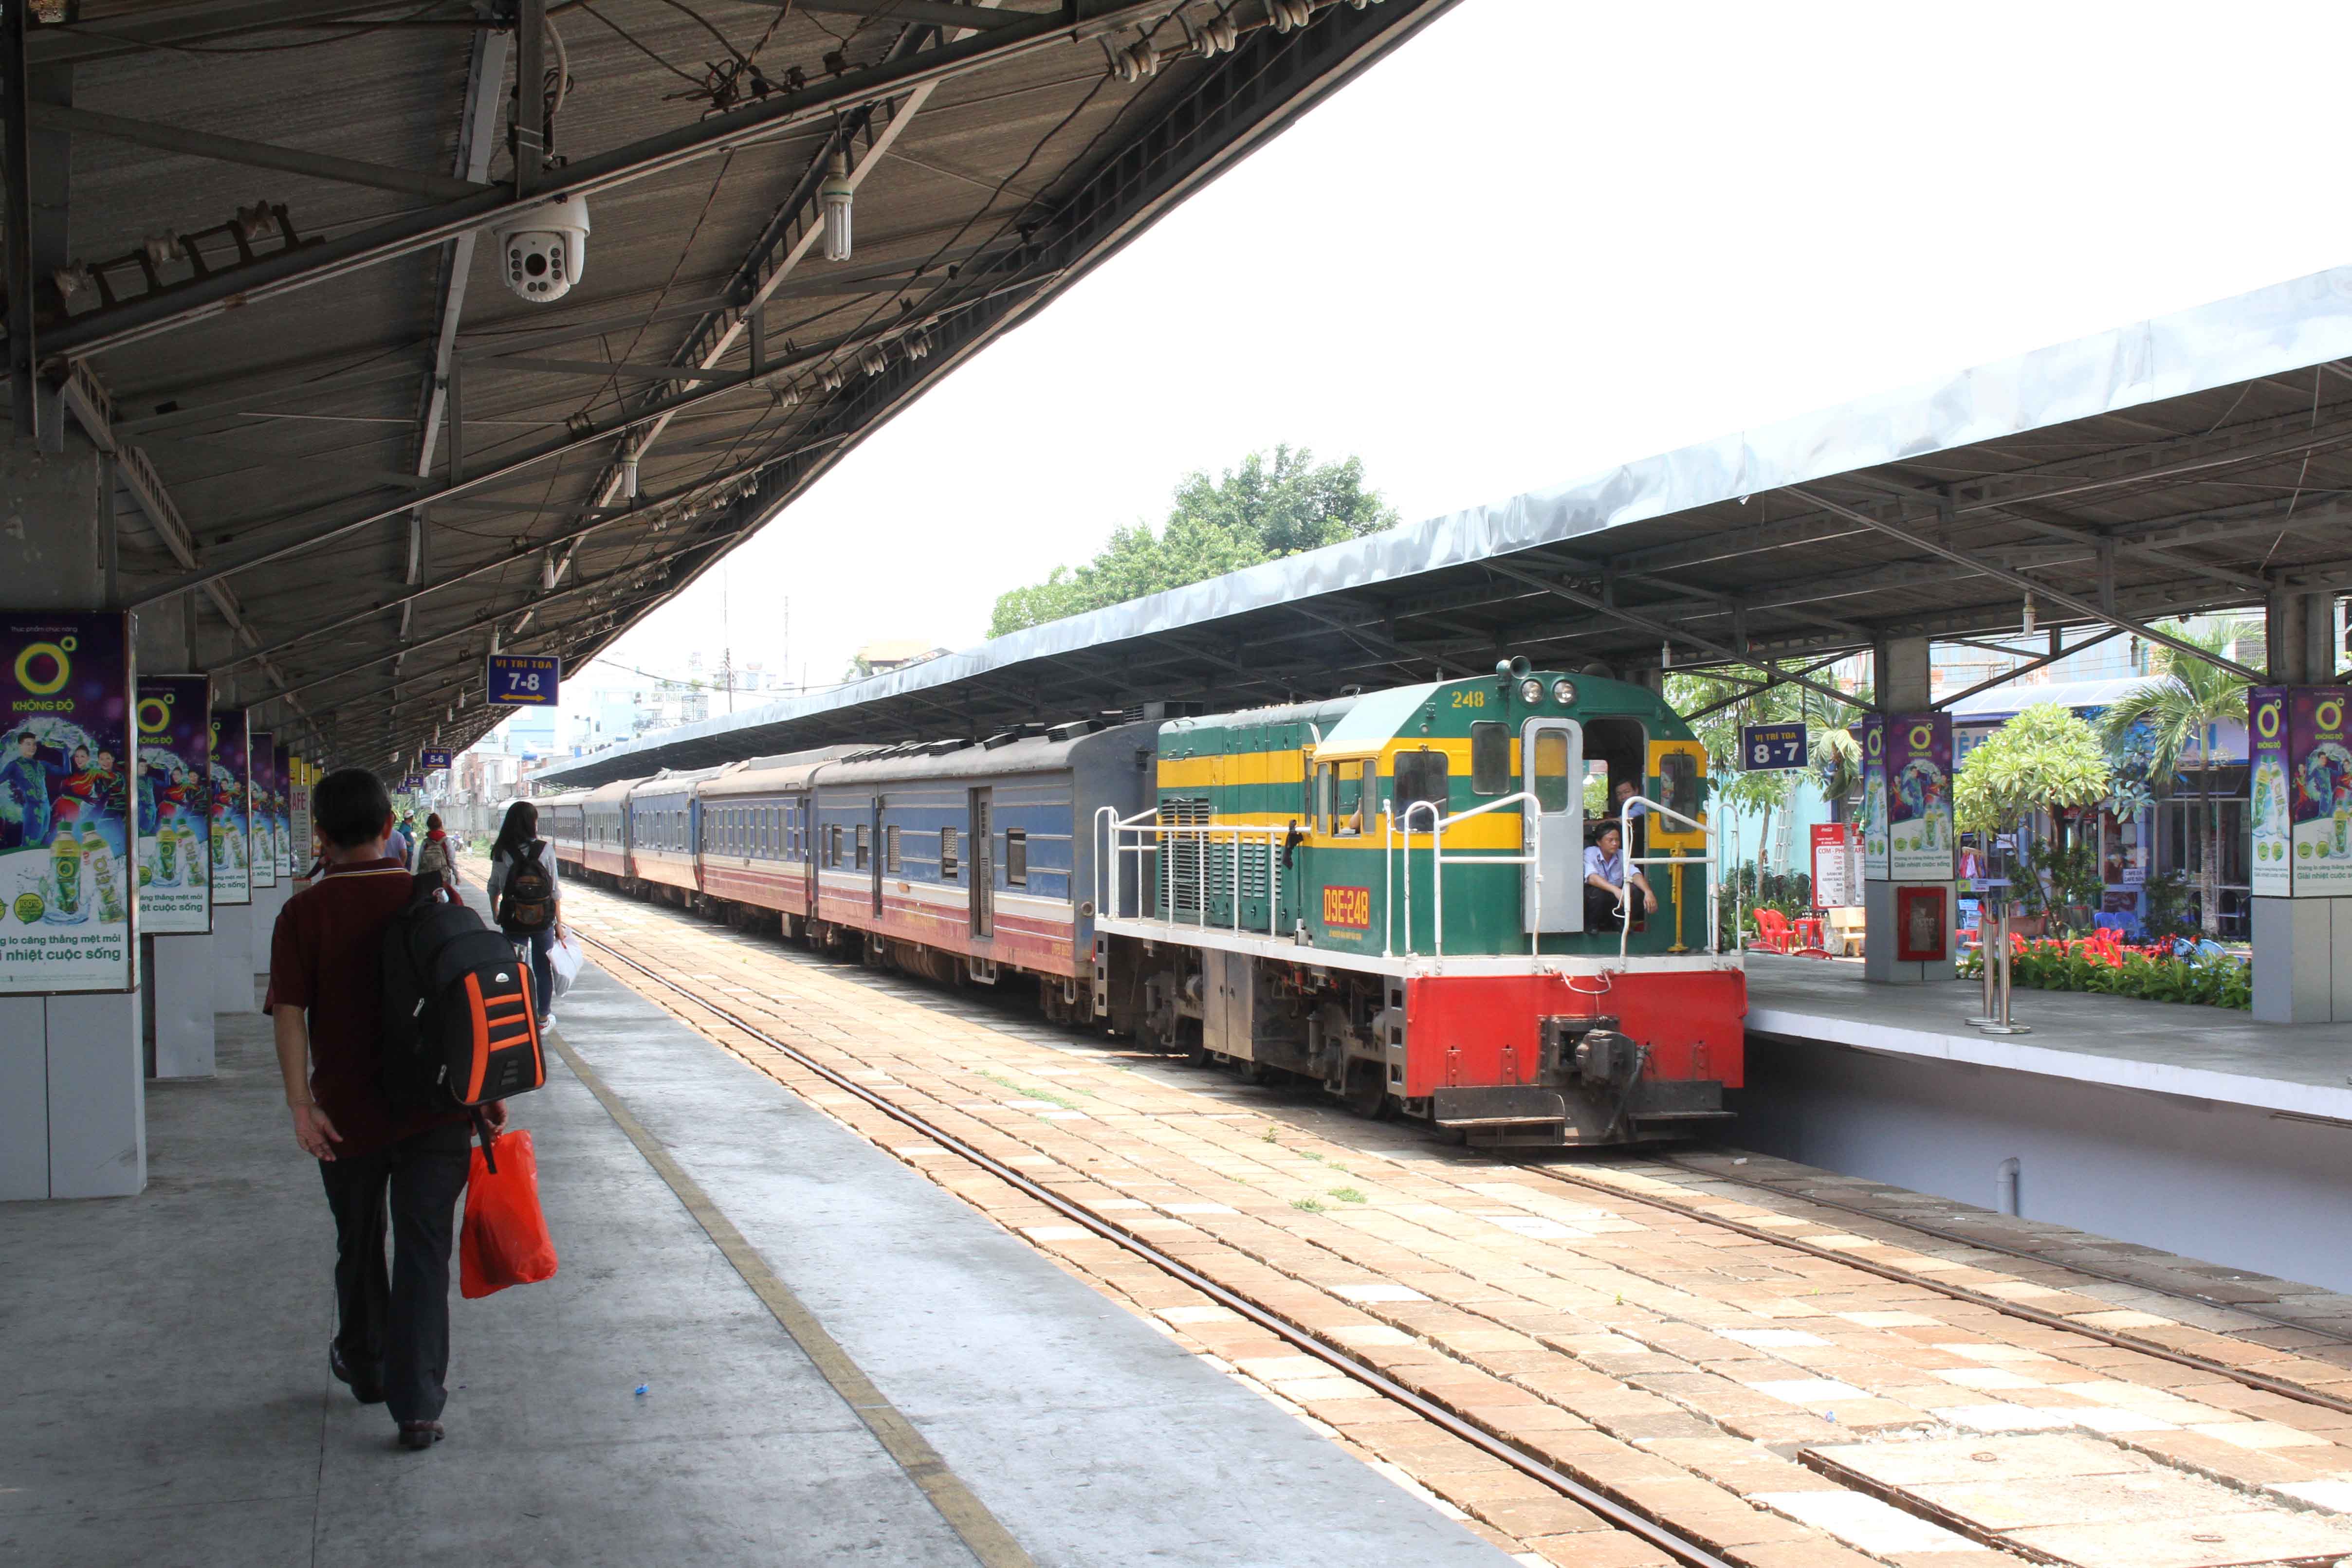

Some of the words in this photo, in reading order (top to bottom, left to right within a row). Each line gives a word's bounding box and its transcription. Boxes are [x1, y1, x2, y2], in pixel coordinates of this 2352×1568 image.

[496, 659, 507, 669] VỊ
[531, 660, 552, 669] TOA
[508, 673, 540, 691] 7-8
[12, 699, 54, 711] KHÔNG
[56, 699, 74, 712] ĐỘ
[1452, 691, 1484, 708] 248
[1754, 734, 1763, 743] VỊ
[1765, 731, 1779, 740] TRÍ
[2335, 731, 2344, 740] ĐỘ
[430, 755, 444, 763] 5-6
[289, 792, 306, 810] AFE
[227, 880, 246, 889] sống
[153, 904, 177, 913] cuộc
[179, 902, 203, 912] sống
[1324, 888, 1368, 925] D9E-248
[21, 935, 46, 946] căng
[49, 934, 78, 945] thẳng
[81, 935, 100, 944] mệt
[103, 933, 121, 943] mỏi
[6, 949, 43, 963] nhiệt
[46, 949, 82, 961] cuộc
[86, 947, 121, 961] sống
